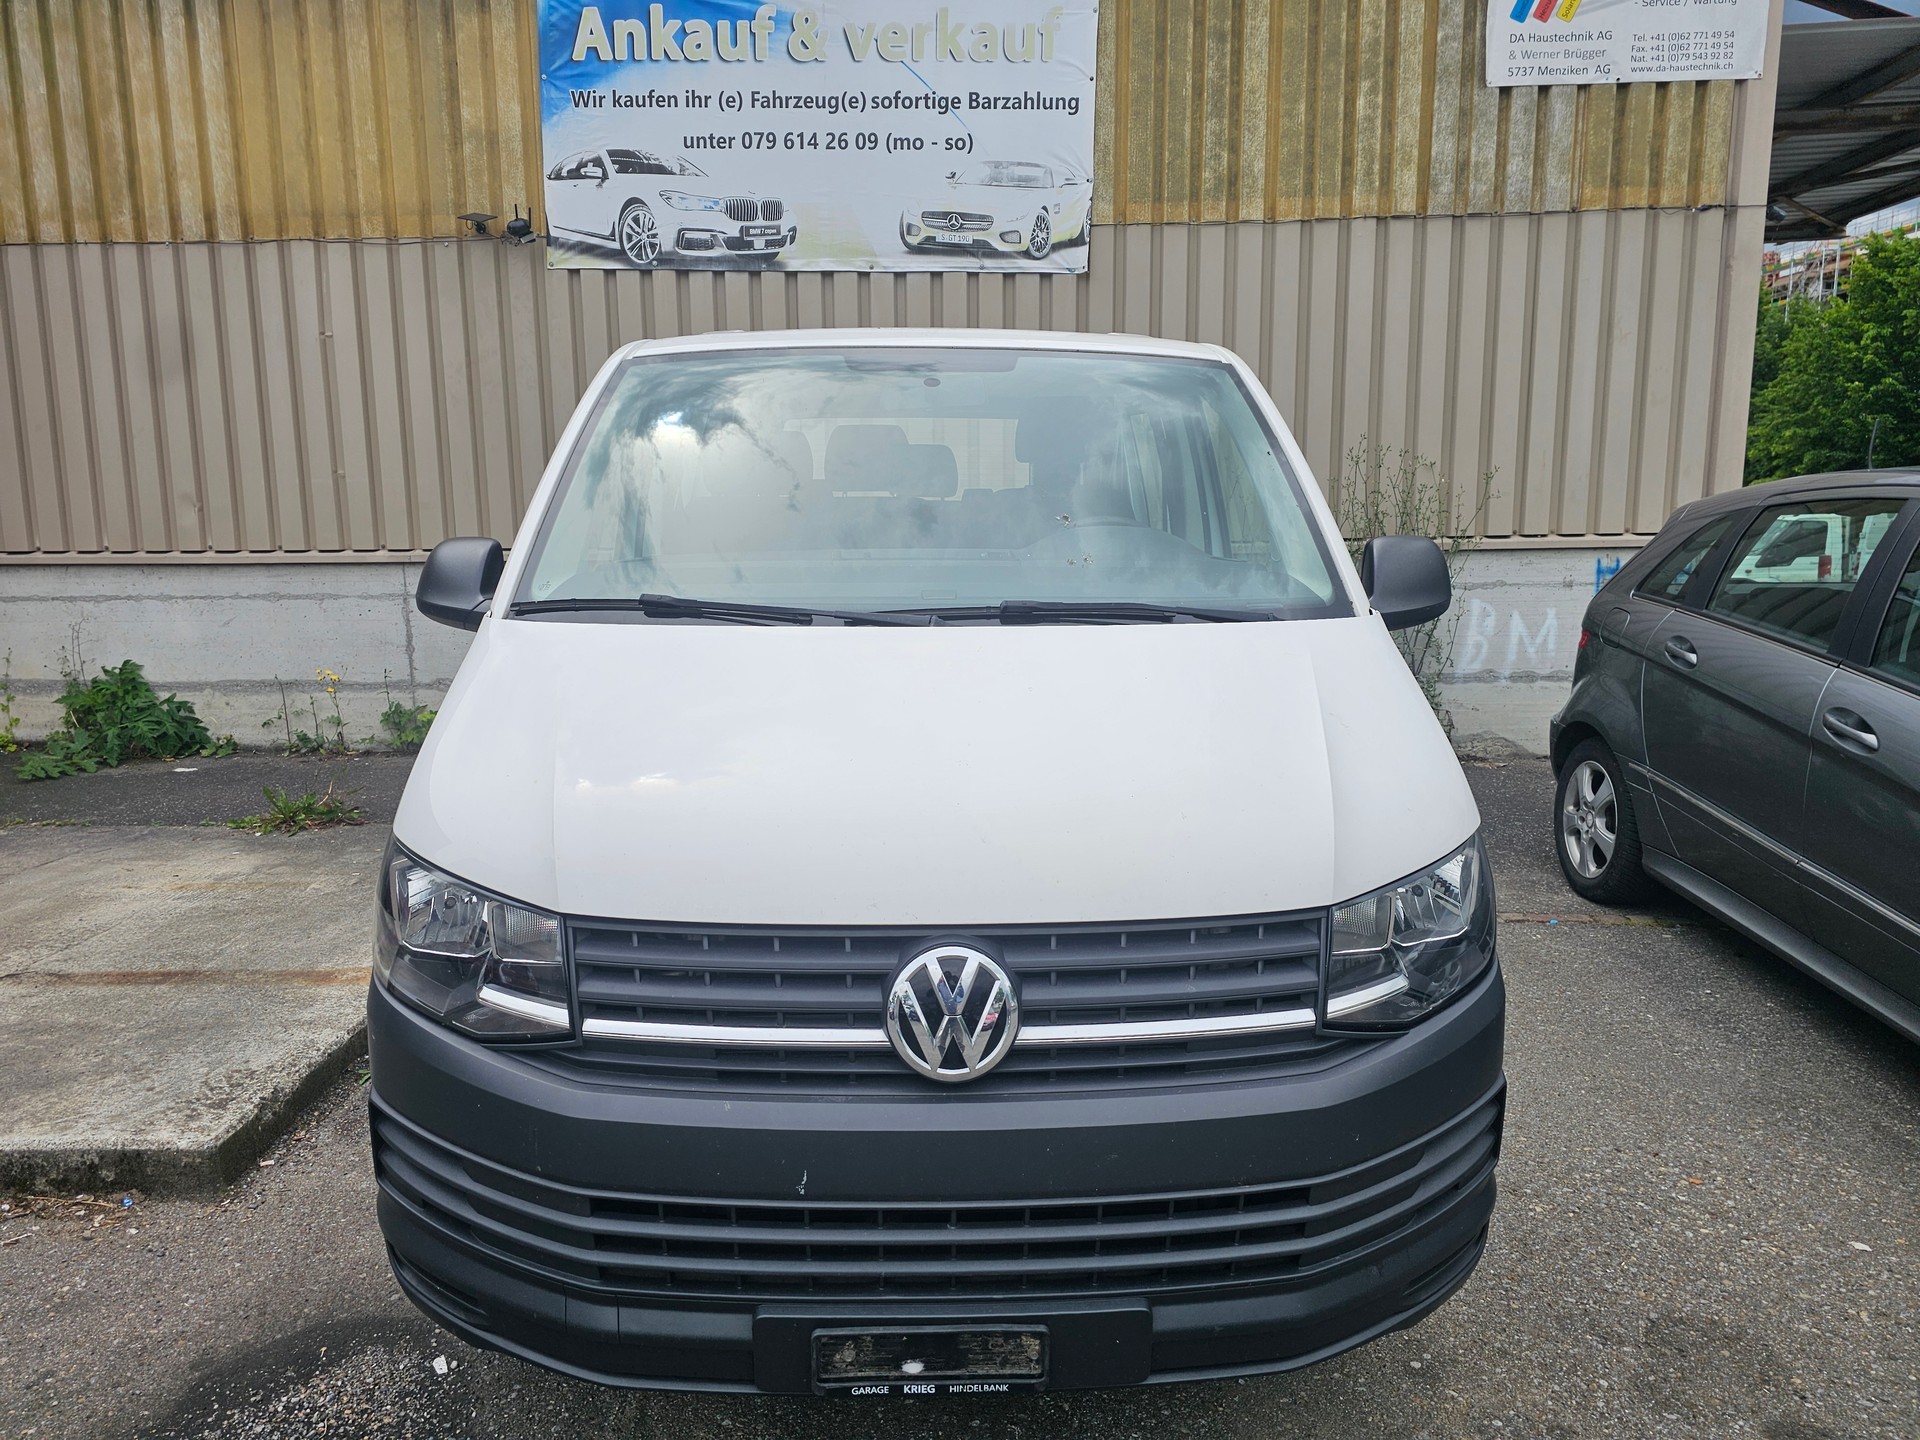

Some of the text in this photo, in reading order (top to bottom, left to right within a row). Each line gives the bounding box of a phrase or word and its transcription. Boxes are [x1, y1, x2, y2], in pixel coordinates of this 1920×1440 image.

[571, 3, 1064, 63] Ankauf & verkauf
[1509, 30, 1613, 43] DA Haustechnik AG
[1632, 30, 1735, 42] Tel. +41 (0)62 771 49 54
[1631, 41, 1734, 53] Fax. +41 (0)62 771 49 54
[1508, 48, 1607, 61] & Werner Brügger
[1630, 51, 1734, 63] Nat. +41 (0)79 543 92 82
[1507, 64, 1611, 77] 5737 Menziken AG
[1630, 62, 1734, 73] www.da-haustechnik.ch
[570, 89, 1080, 115] Wir kaufen ihr (e) Fahrzeug(e) sofortige Barzahlung
[683, 132, 736, 149] unter
[741, 131, 778, 150] 079
[783, 131, 819, 150] 614
[825, 132, 849, 150] 26
[855, 132, 879, 150] 09
[885, 132, 925, 154] (mo
[944, 132, 974, 154] so)
[893, 950, 1011, 1078] VW
[851, 1384, 1009, 1395] GARAGE KRIEG HINDELBANK
